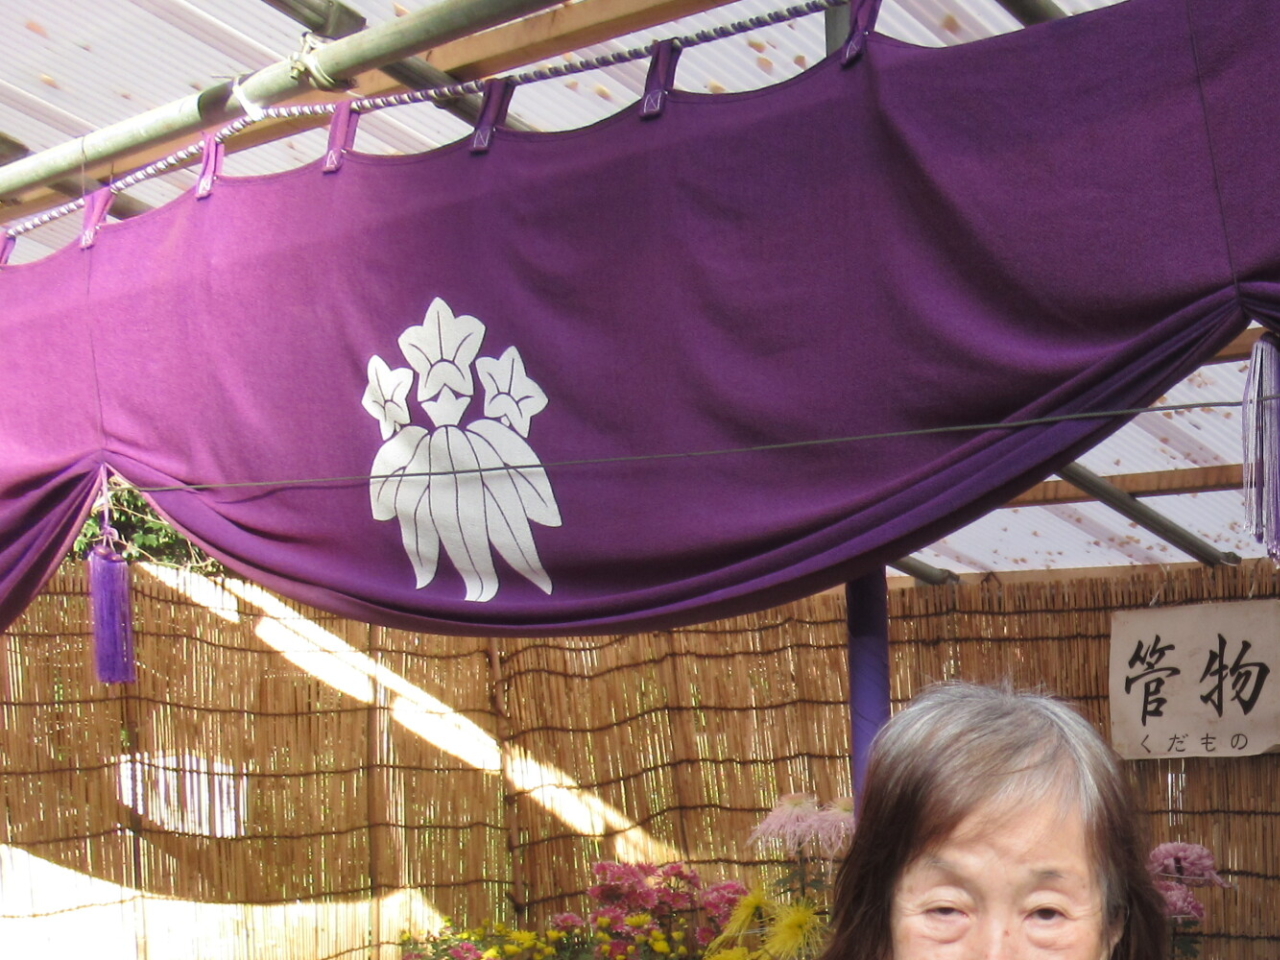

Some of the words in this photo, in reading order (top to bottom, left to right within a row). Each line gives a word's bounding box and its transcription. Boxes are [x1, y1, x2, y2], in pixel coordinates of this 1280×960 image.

[1125, 633, 1271, 727] 管物
[1140, 733, 1248, 753] くだもの
